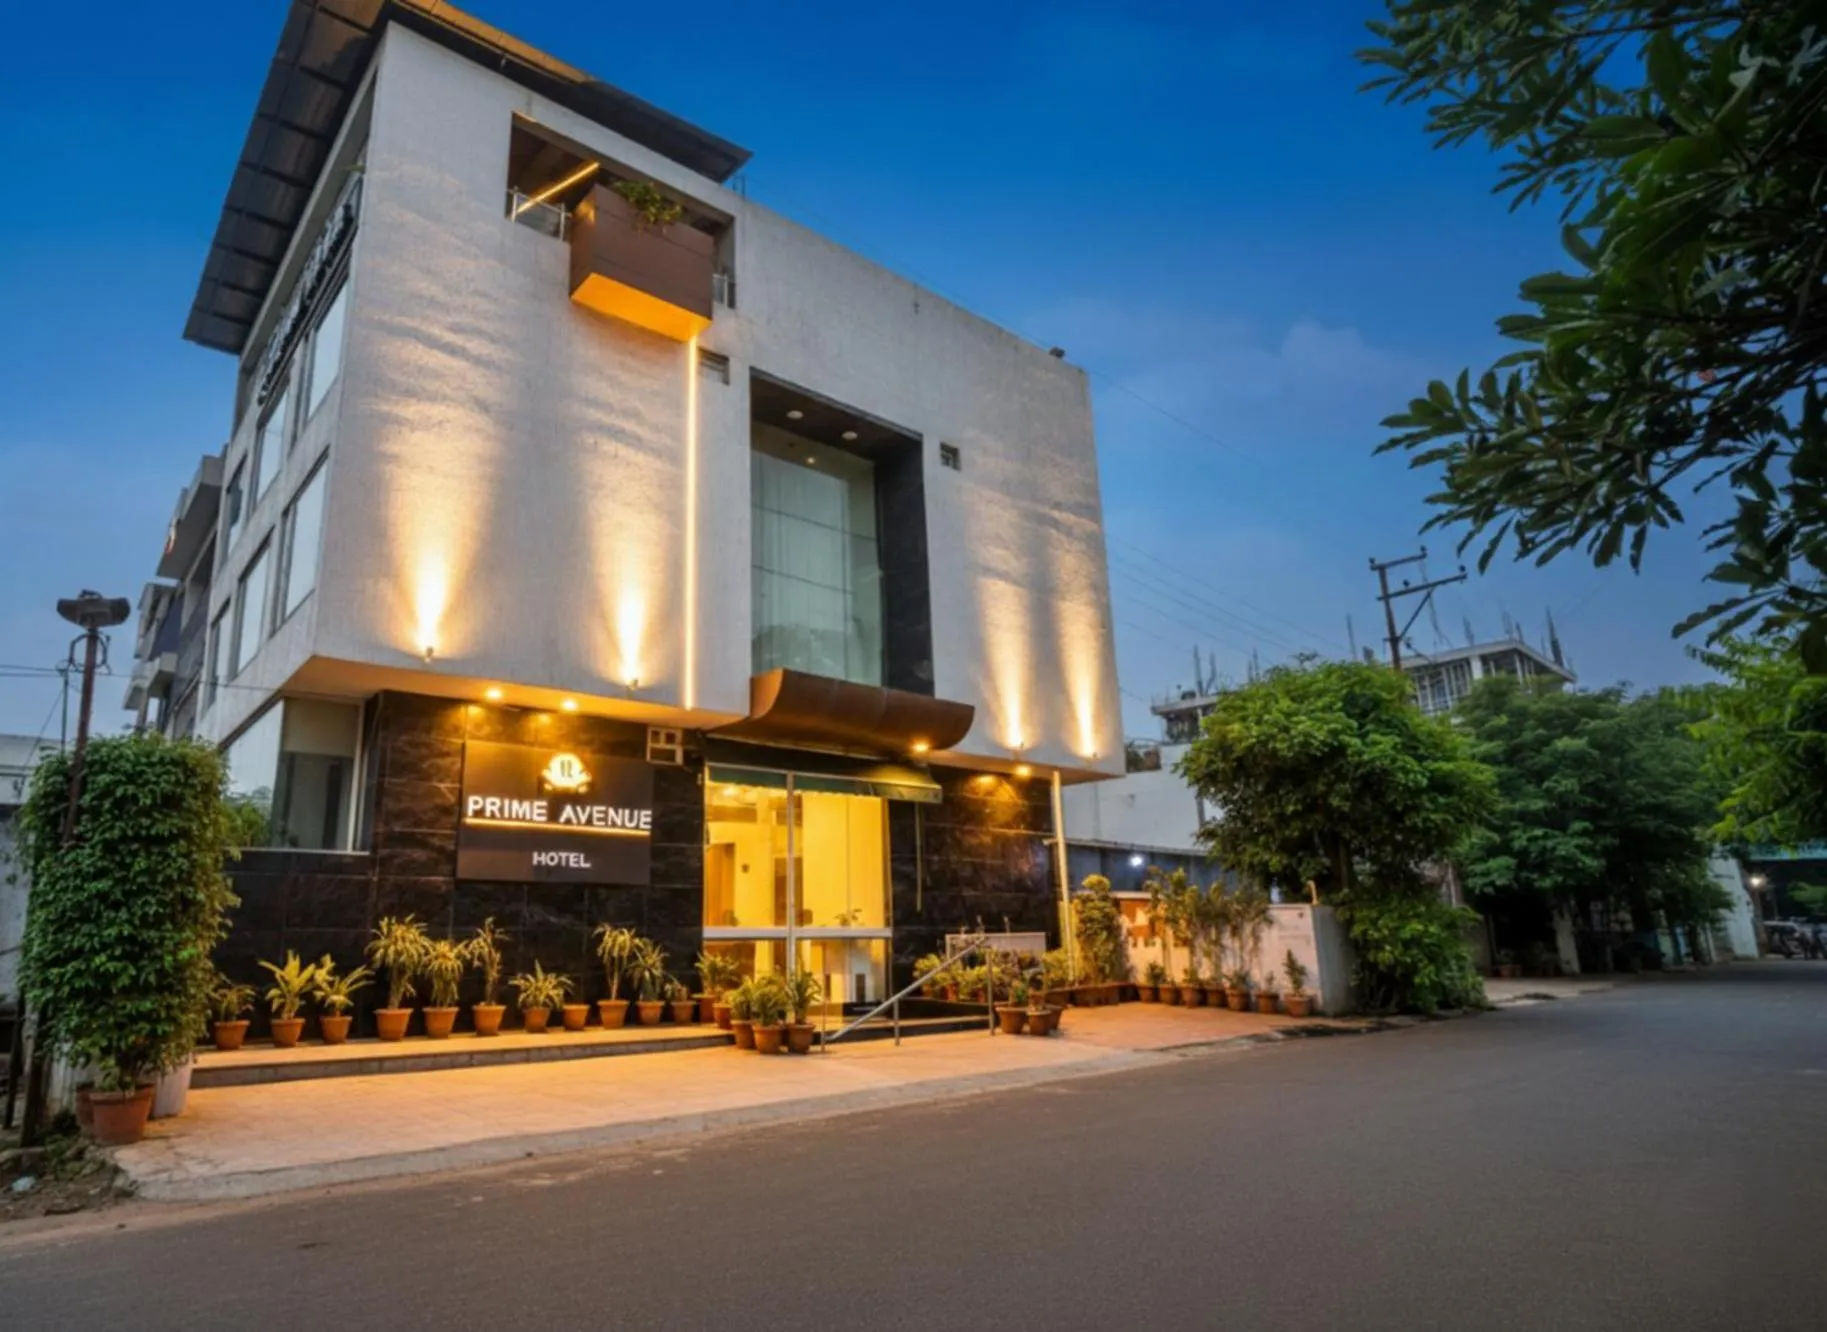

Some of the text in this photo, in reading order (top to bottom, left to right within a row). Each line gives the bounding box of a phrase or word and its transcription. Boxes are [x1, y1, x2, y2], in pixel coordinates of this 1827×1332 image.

[467, 796, 652, 829] PRIME AVENUE
[532, 851, 591, 868] HOTEL
